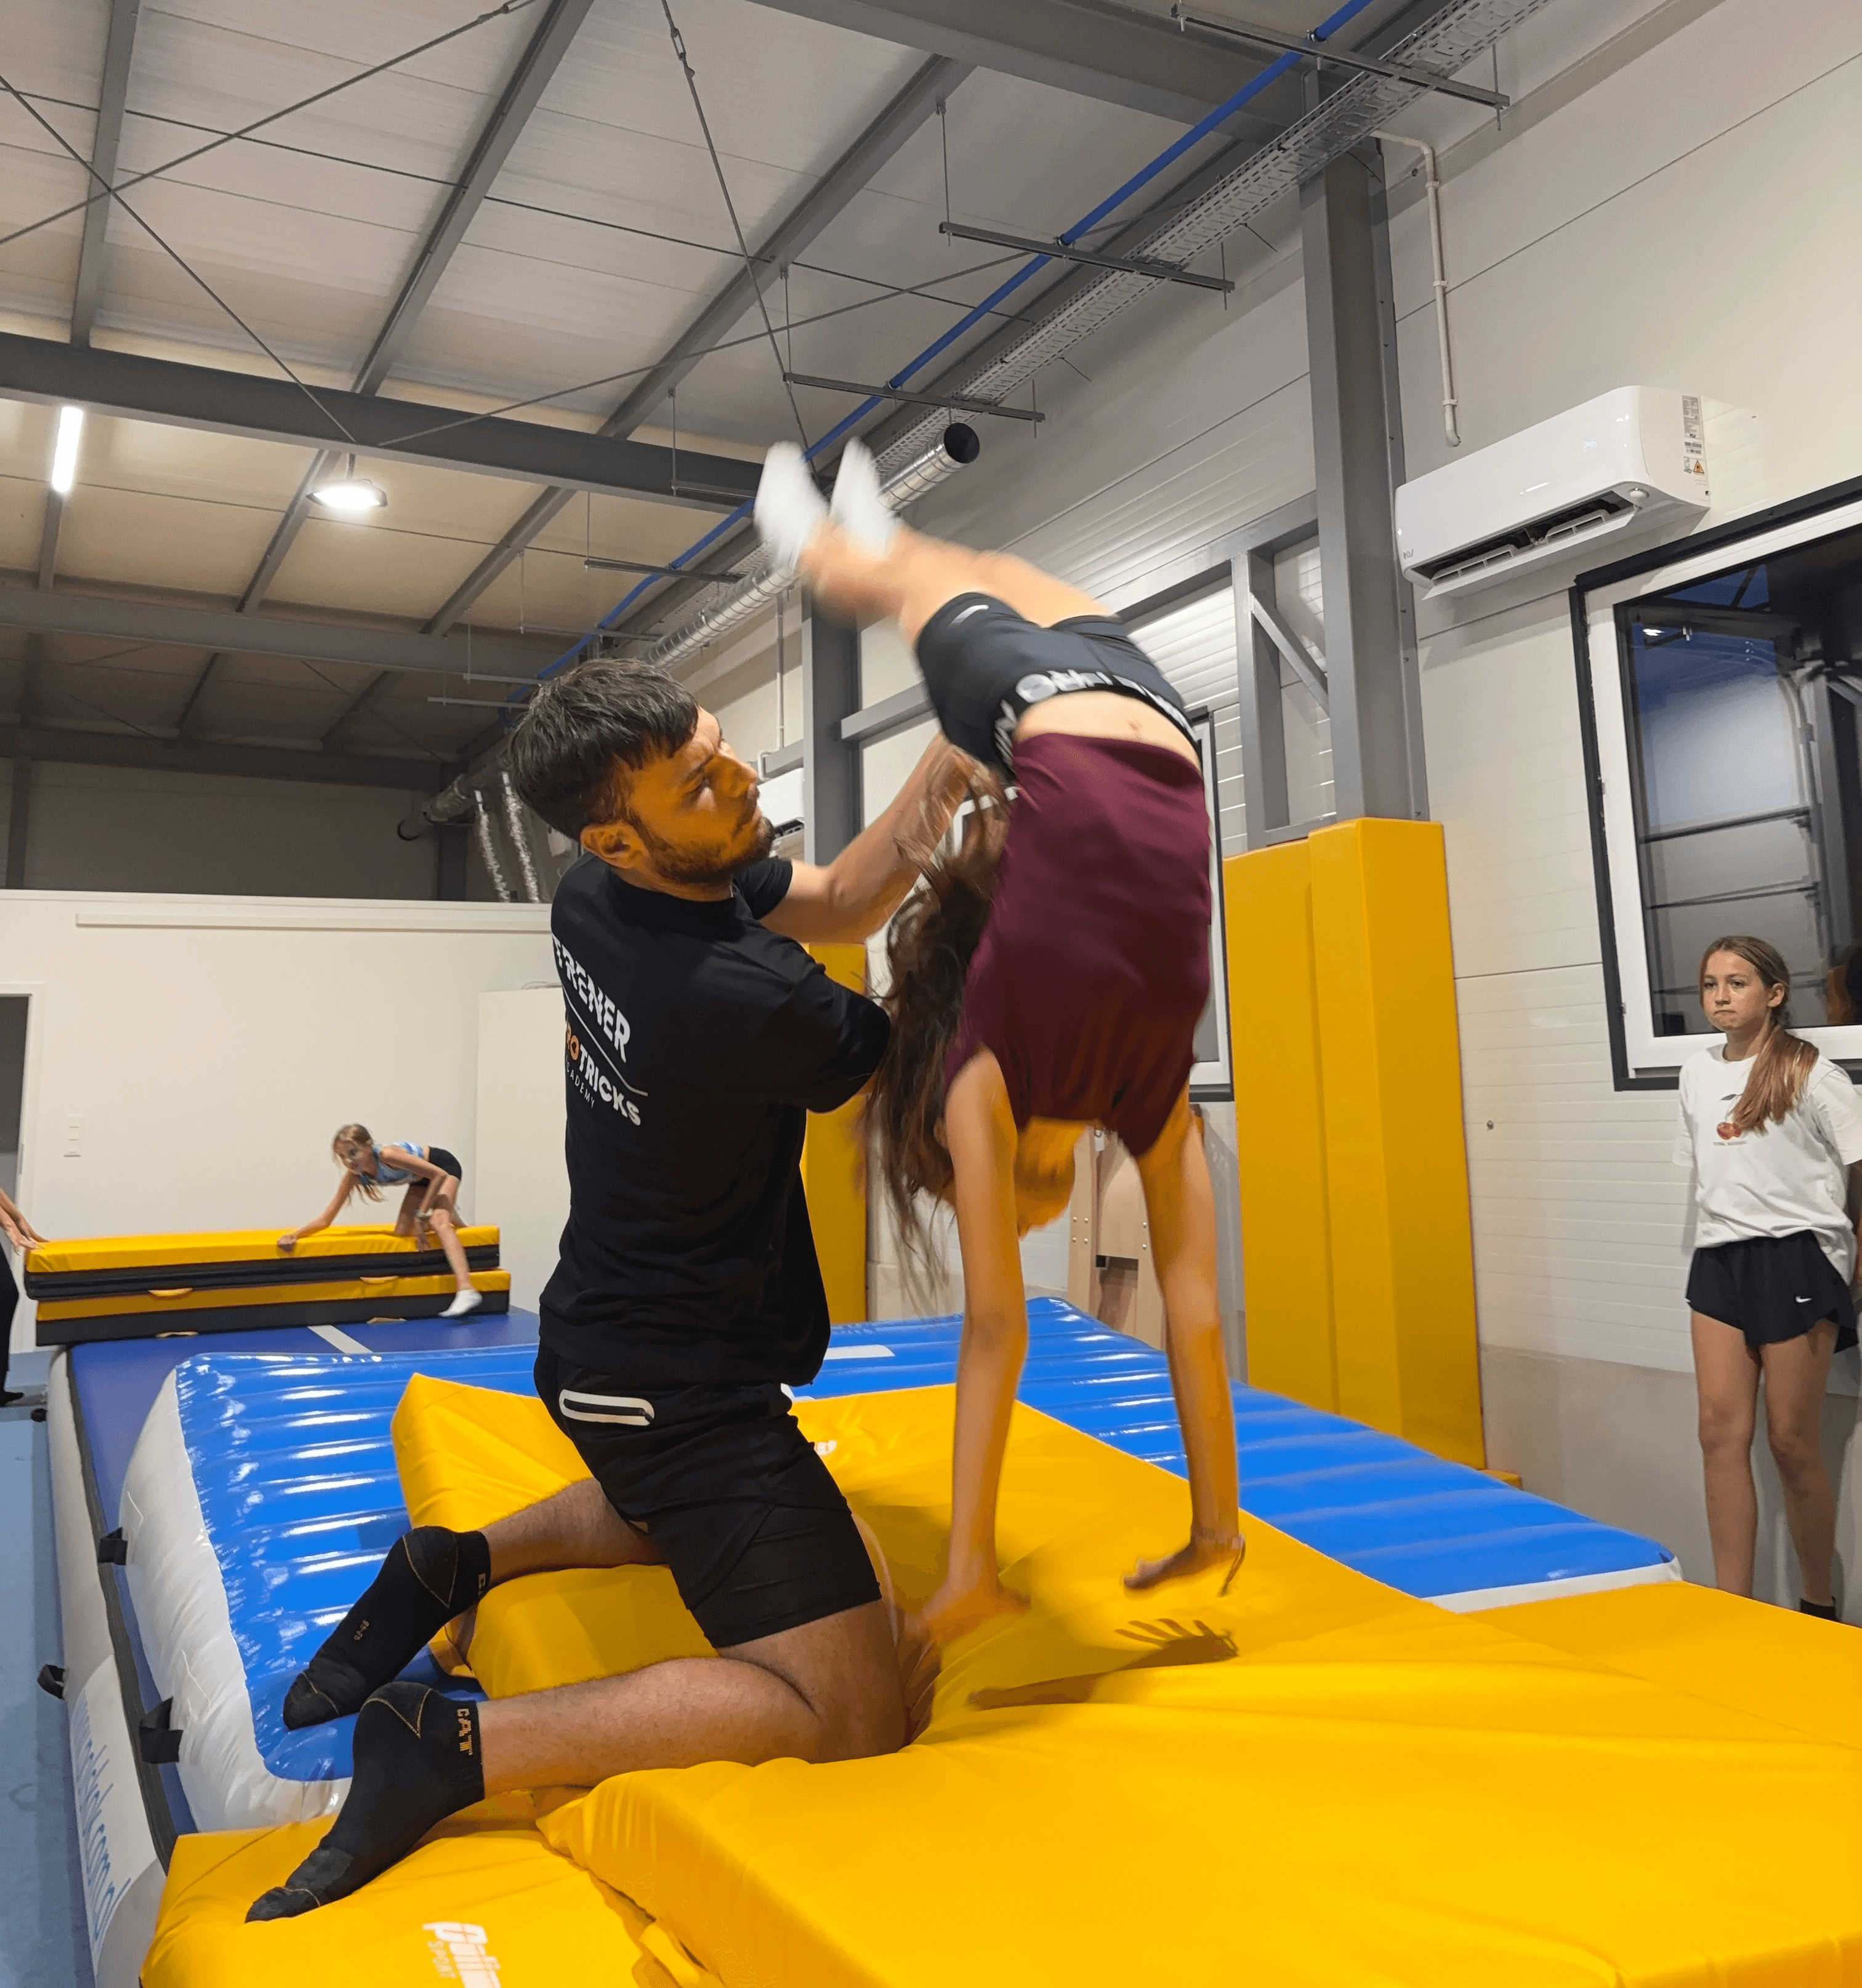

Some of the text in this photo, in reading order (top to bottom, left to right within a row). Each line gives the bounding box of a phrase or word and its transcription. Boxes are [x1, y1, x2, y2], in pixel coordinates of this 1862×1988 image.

[552, 933, 631, 1064] TRENER
[565, 1055, 595, 1109] CADEMY
[566, 1019, 642, 1126] ROTRICKS
[457, 1708, 474, 1756] CAT
